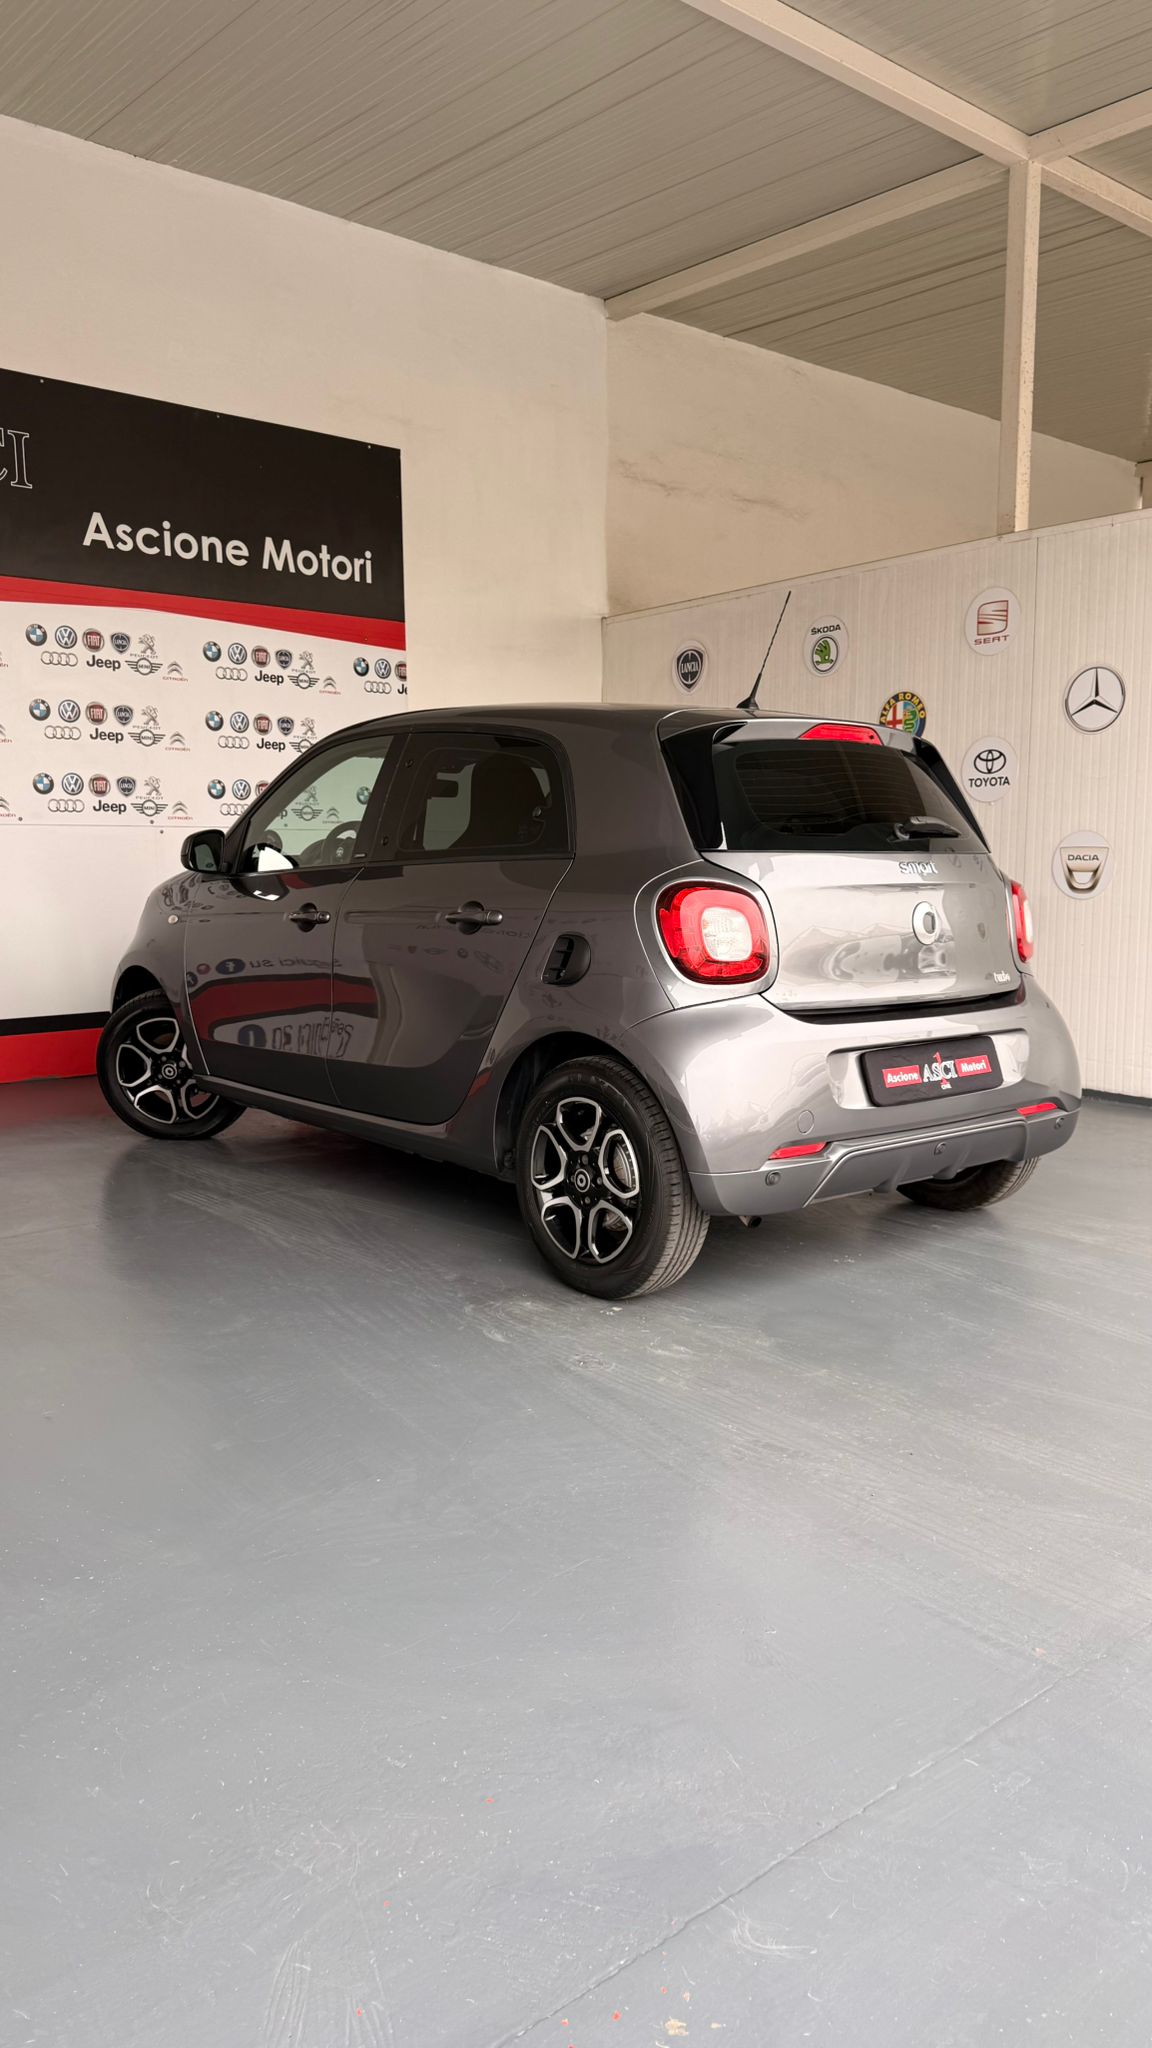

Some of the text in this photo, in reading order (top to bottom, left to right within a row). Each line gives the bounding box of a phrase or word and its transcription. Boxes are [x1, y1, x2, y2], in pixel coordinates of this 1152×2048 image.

[82, 511, 373, 584] Ascione Motori
[811, 624, 842, 635] ŠKODA
[974, 634, 1010, 646] SEAT
[86, 655, 121, 671] Jeep
[255, 670, 284, 685] Jeep
[880, 693, 925, 723] ALFA ROMEO
[90, 728, 124, 744] Jeep
[257, 738, 286, 752] Jeep
[968, 776, 1010, 788] TOYOTA
[93, 800, 127, 814] Jeep
[1067, 854, 1099, 862] DACIA
[899, 861, 938, 874] smart
[887, 1060, 987, 1083] Ascione ASCI Motori
